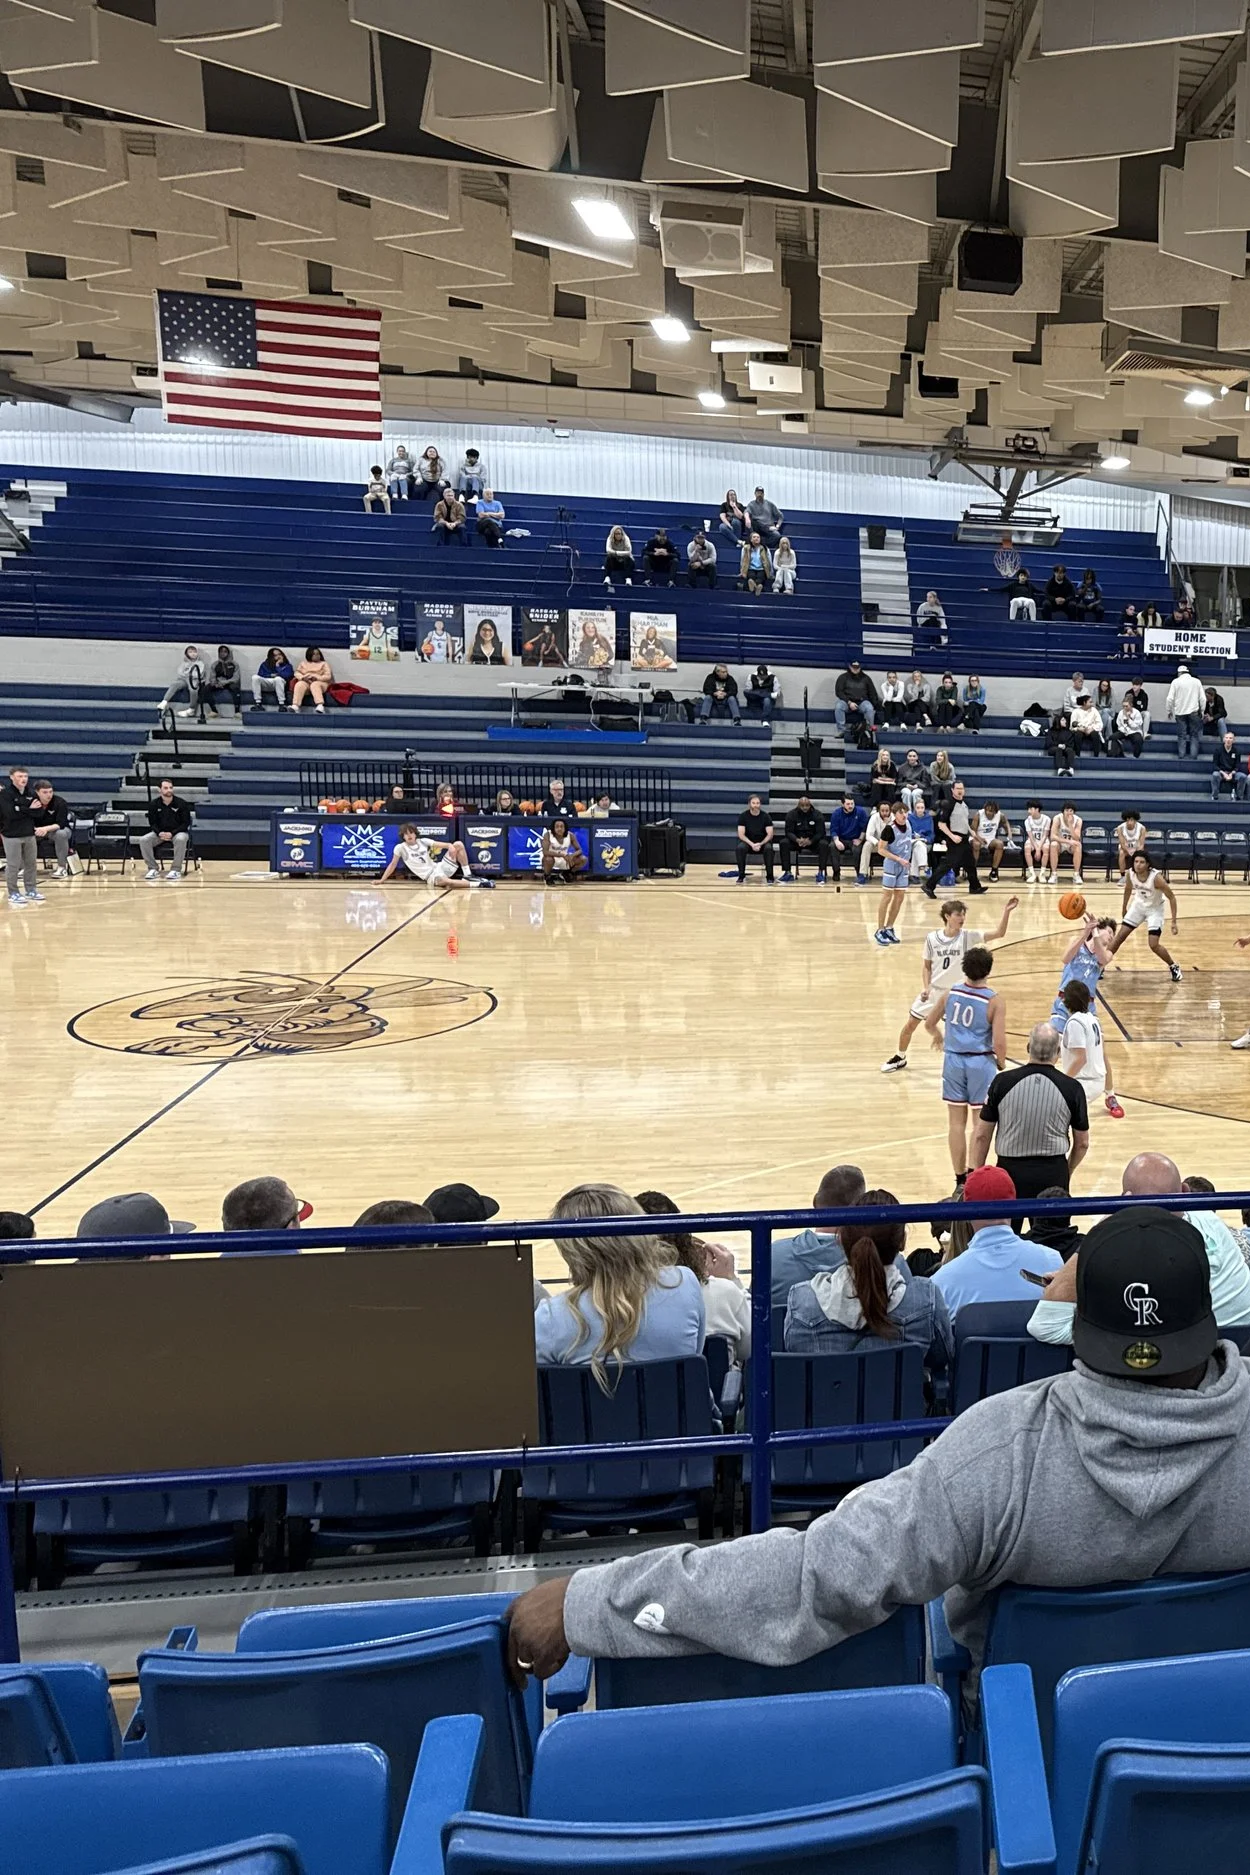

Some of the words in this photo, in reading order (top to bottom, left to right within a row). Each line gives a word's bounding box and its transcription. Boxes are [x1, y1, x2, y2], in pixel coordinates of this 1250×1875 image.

[1175, 633, 1206, 643] HOME
[1149, 644, 1190, 652] STUDENT
[1193, 646, 1231, 654] SECTION
[943, 957, 950, 969] 0
[951, 1002, 974, 1027] 10
[1123, 1282, 1163, 1326] CR
